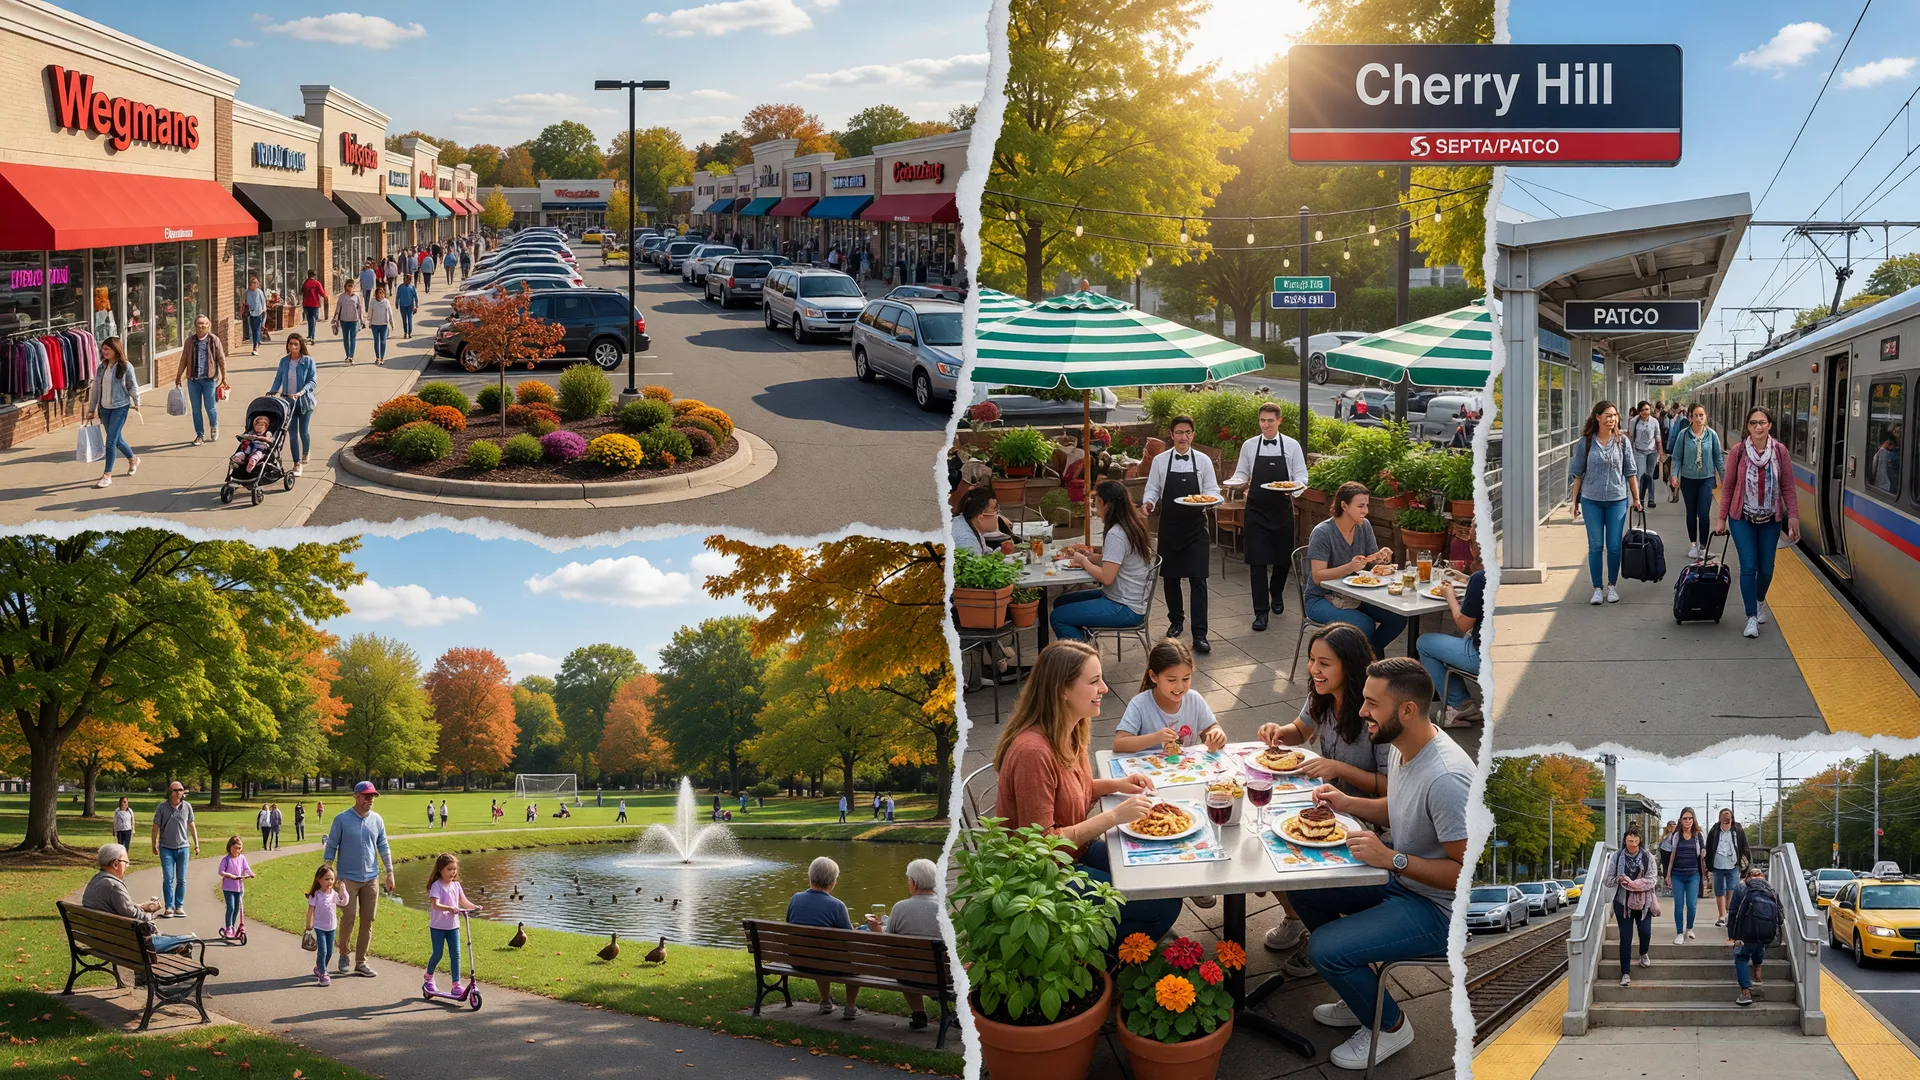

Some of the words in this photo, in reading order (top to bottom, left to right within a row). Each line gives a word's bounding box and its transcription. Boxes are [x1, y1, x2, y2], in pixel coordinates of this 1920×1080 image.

[47, 64, 199, 151] Wegmans
[1355, 62, 1521, 117] Cherry
[1537, 62, 1613, 105] Hill
[1435, 138, 1560, 155] SEPTA/PATCO
[1593, 307, 1660, 326] PATCO
